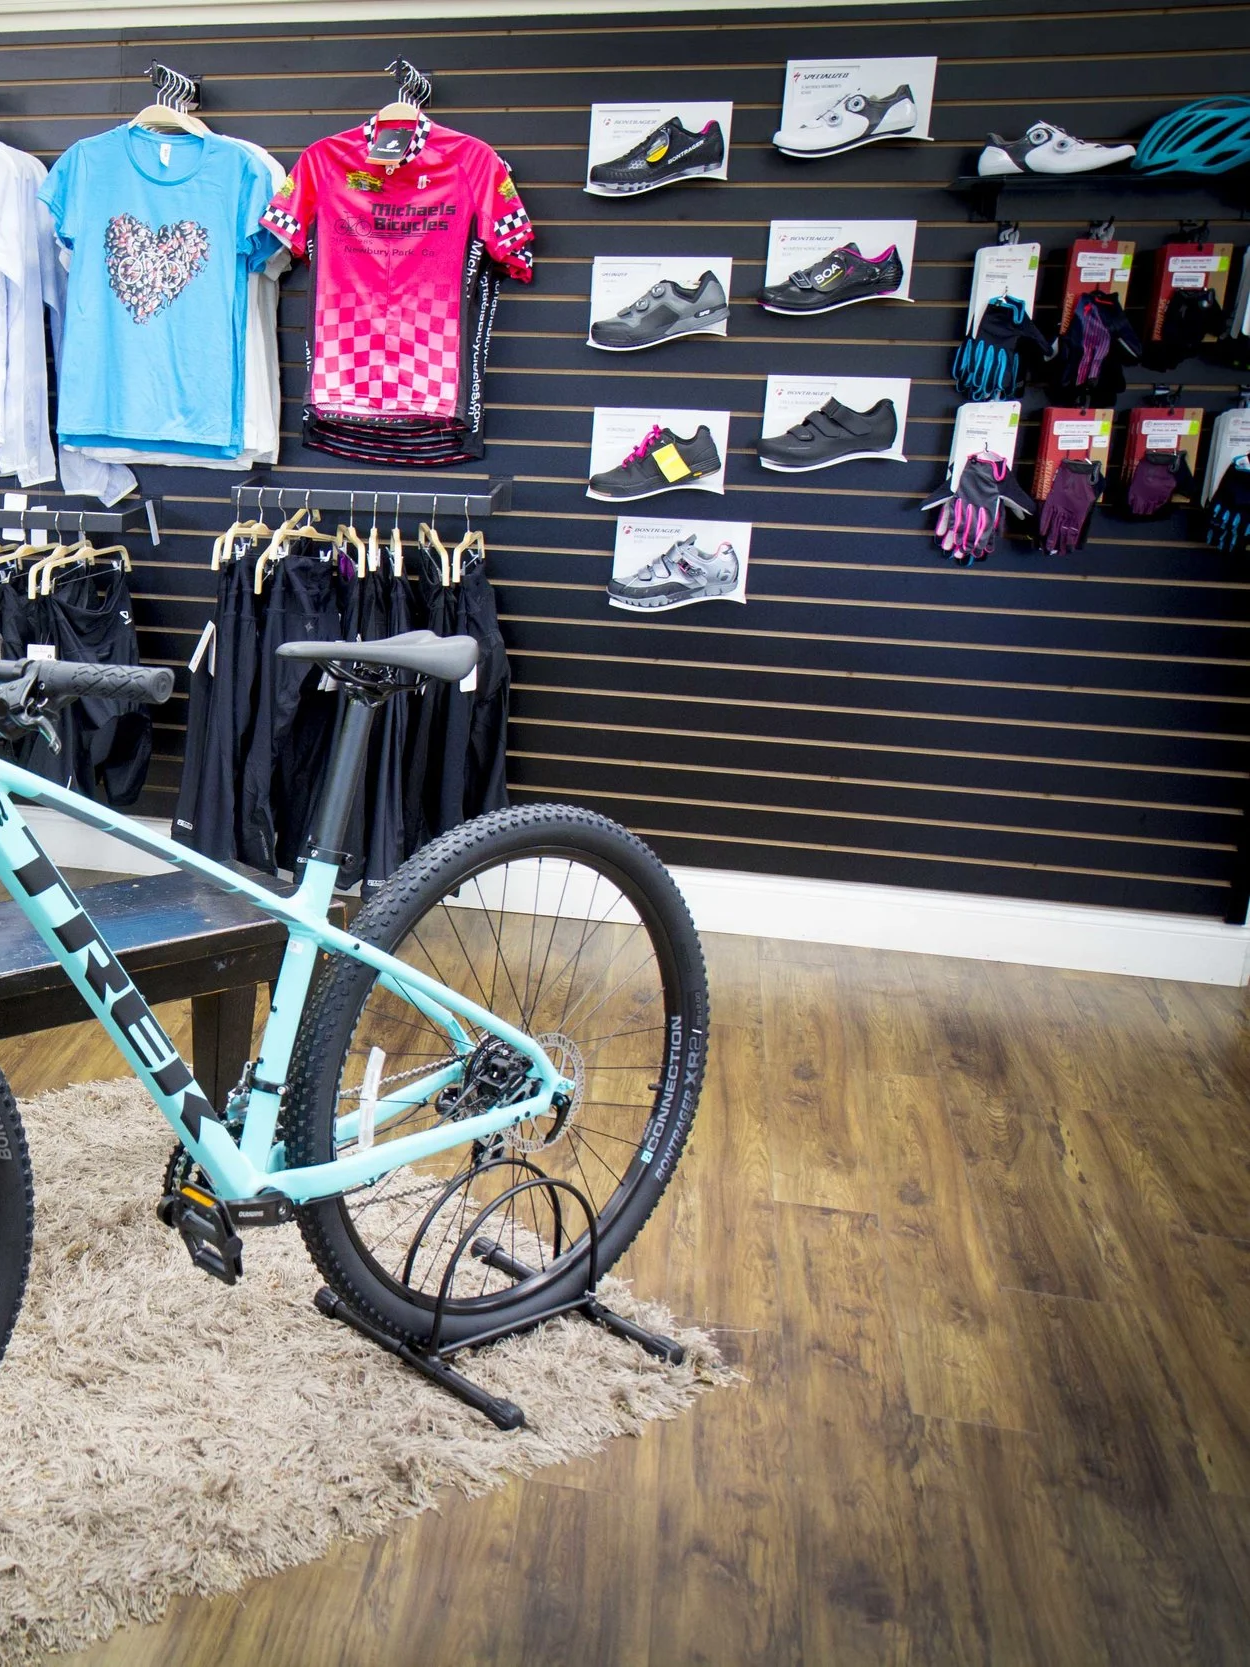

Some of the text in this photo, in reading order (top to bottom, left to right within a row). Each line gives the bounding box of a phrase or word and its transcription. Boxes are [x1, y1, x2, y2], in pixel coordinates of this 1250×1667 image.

[667, 139, 705, 165] BONTRAGER
[371, 203, 456, 216] Michaels
[374, 217, 449, 234] Bicycles
[344, 245, 389, 256] Newbury
[392, 248, 414, 256] Park
[814, 263, 841, 284] BOA
[12, 825, 227, 1144] TREK
[647, 1016, 682, 1152] CONNECTION
[654, 1090, 697, 1182] BONTRAGER
[683, 1036, 702, 1085] XR2
